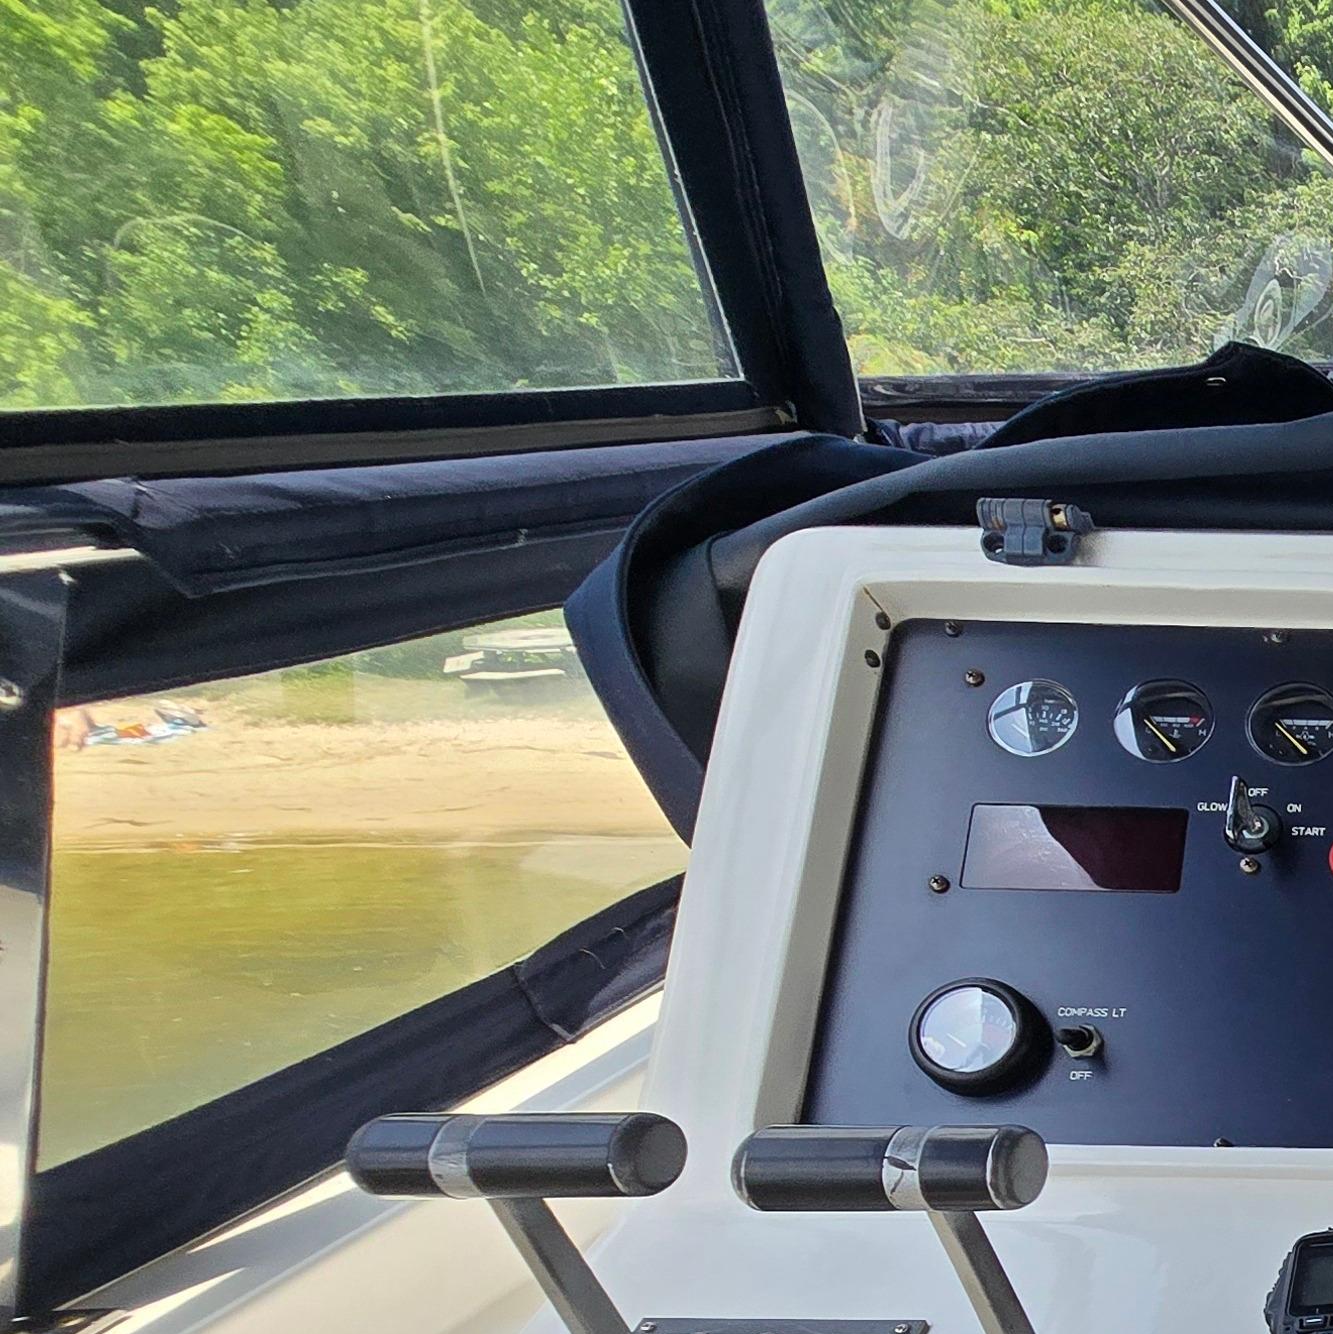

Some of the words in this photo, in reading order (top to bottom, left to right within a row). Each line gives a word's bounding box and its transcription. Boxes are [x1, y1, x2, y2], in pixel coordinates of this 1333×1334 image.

[1248, 788, 1269, 797] OFF
[1197, 802, 1228, 811] GLOW
[1286, 804, 1302, 813] ON
[1291, 827, 1326, 836] START
[1057, 1007, 1109, 1018] COMPASS
[1112, 1008, 1127, 1018] LT
[1069, 1070, 1094, 1081] OFF
